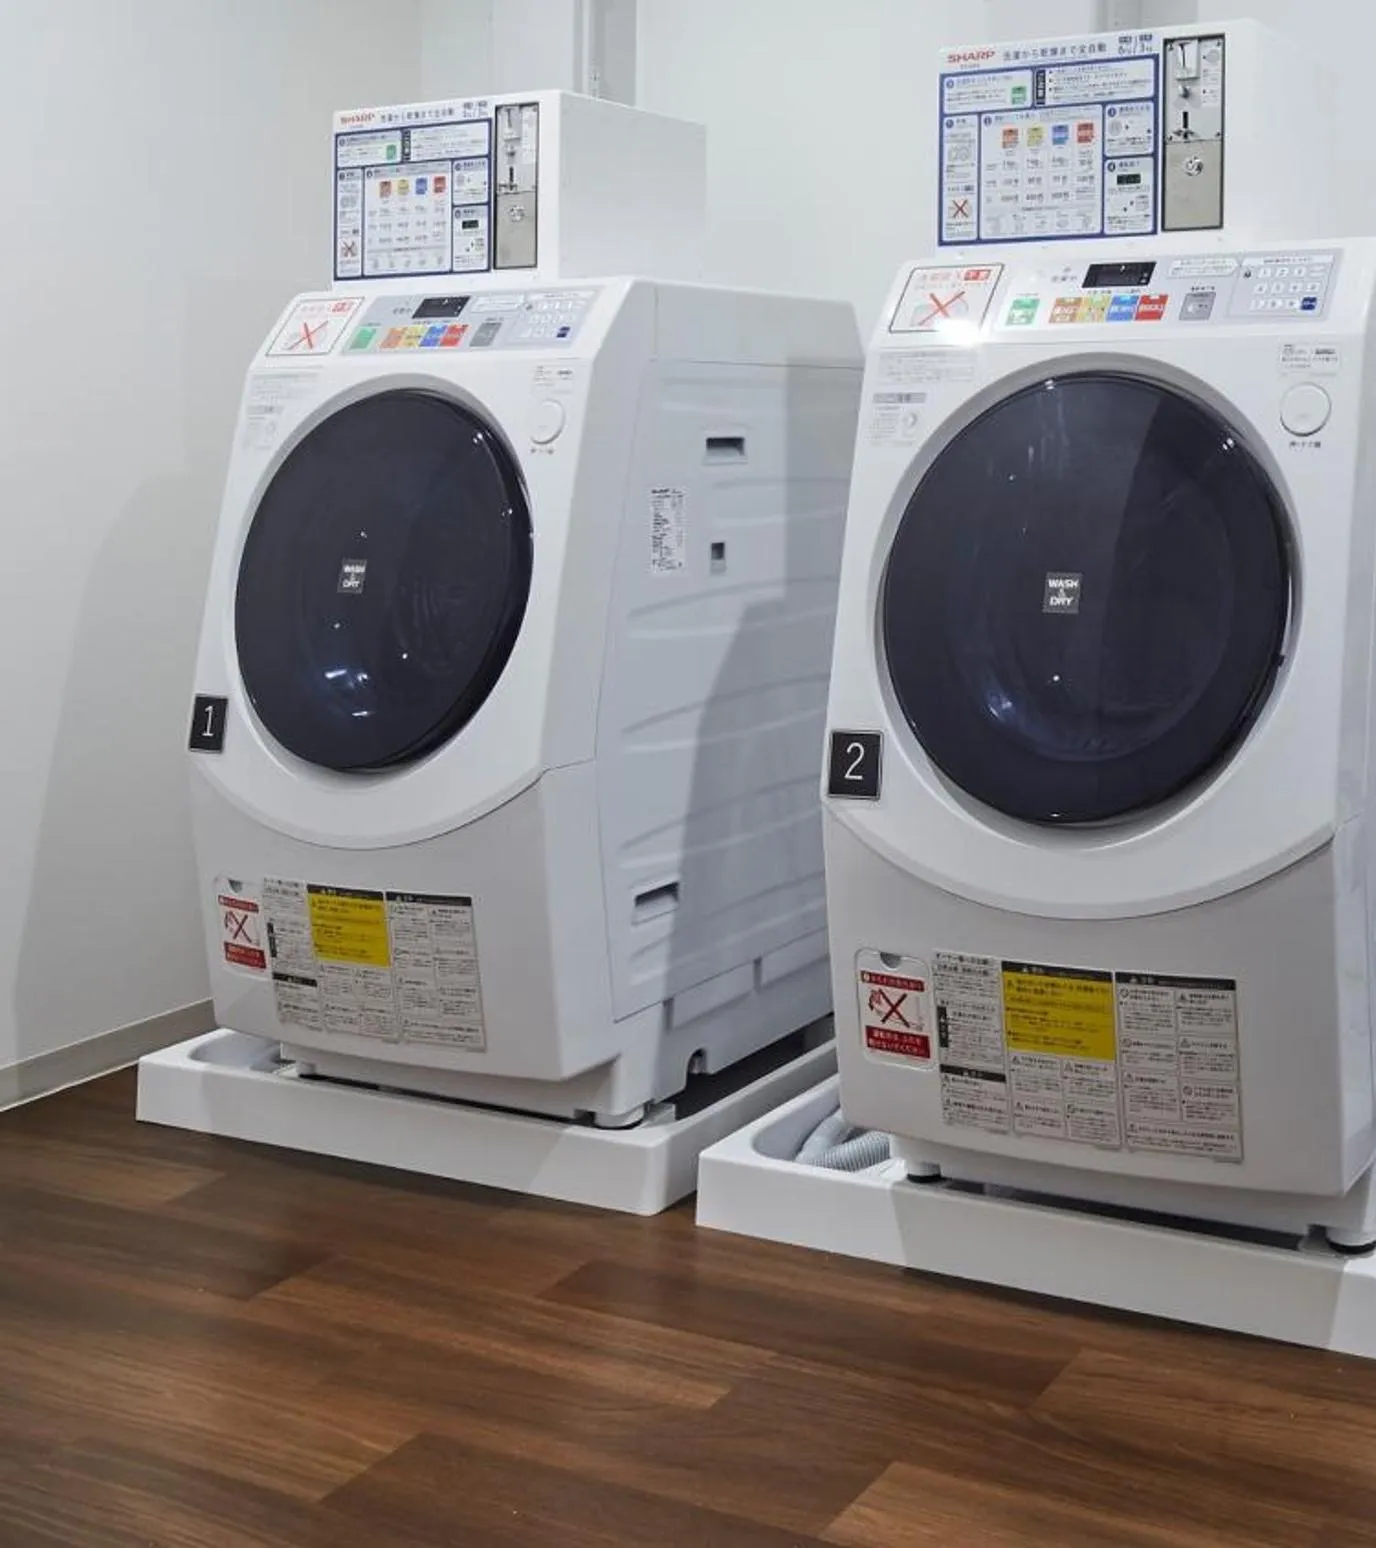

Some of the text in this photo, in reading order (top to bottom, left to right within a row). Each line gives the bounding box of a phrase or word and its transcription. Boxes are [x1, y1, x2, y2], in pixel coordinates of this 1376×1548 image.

[947, 50, 996, 63] SHARP
[1048, 579, 1080, 588] WASH
[1050, 596, 1074, 605] DRY
[202, 705, 214, 736] 1
[844, 742, 865, 780] 2
